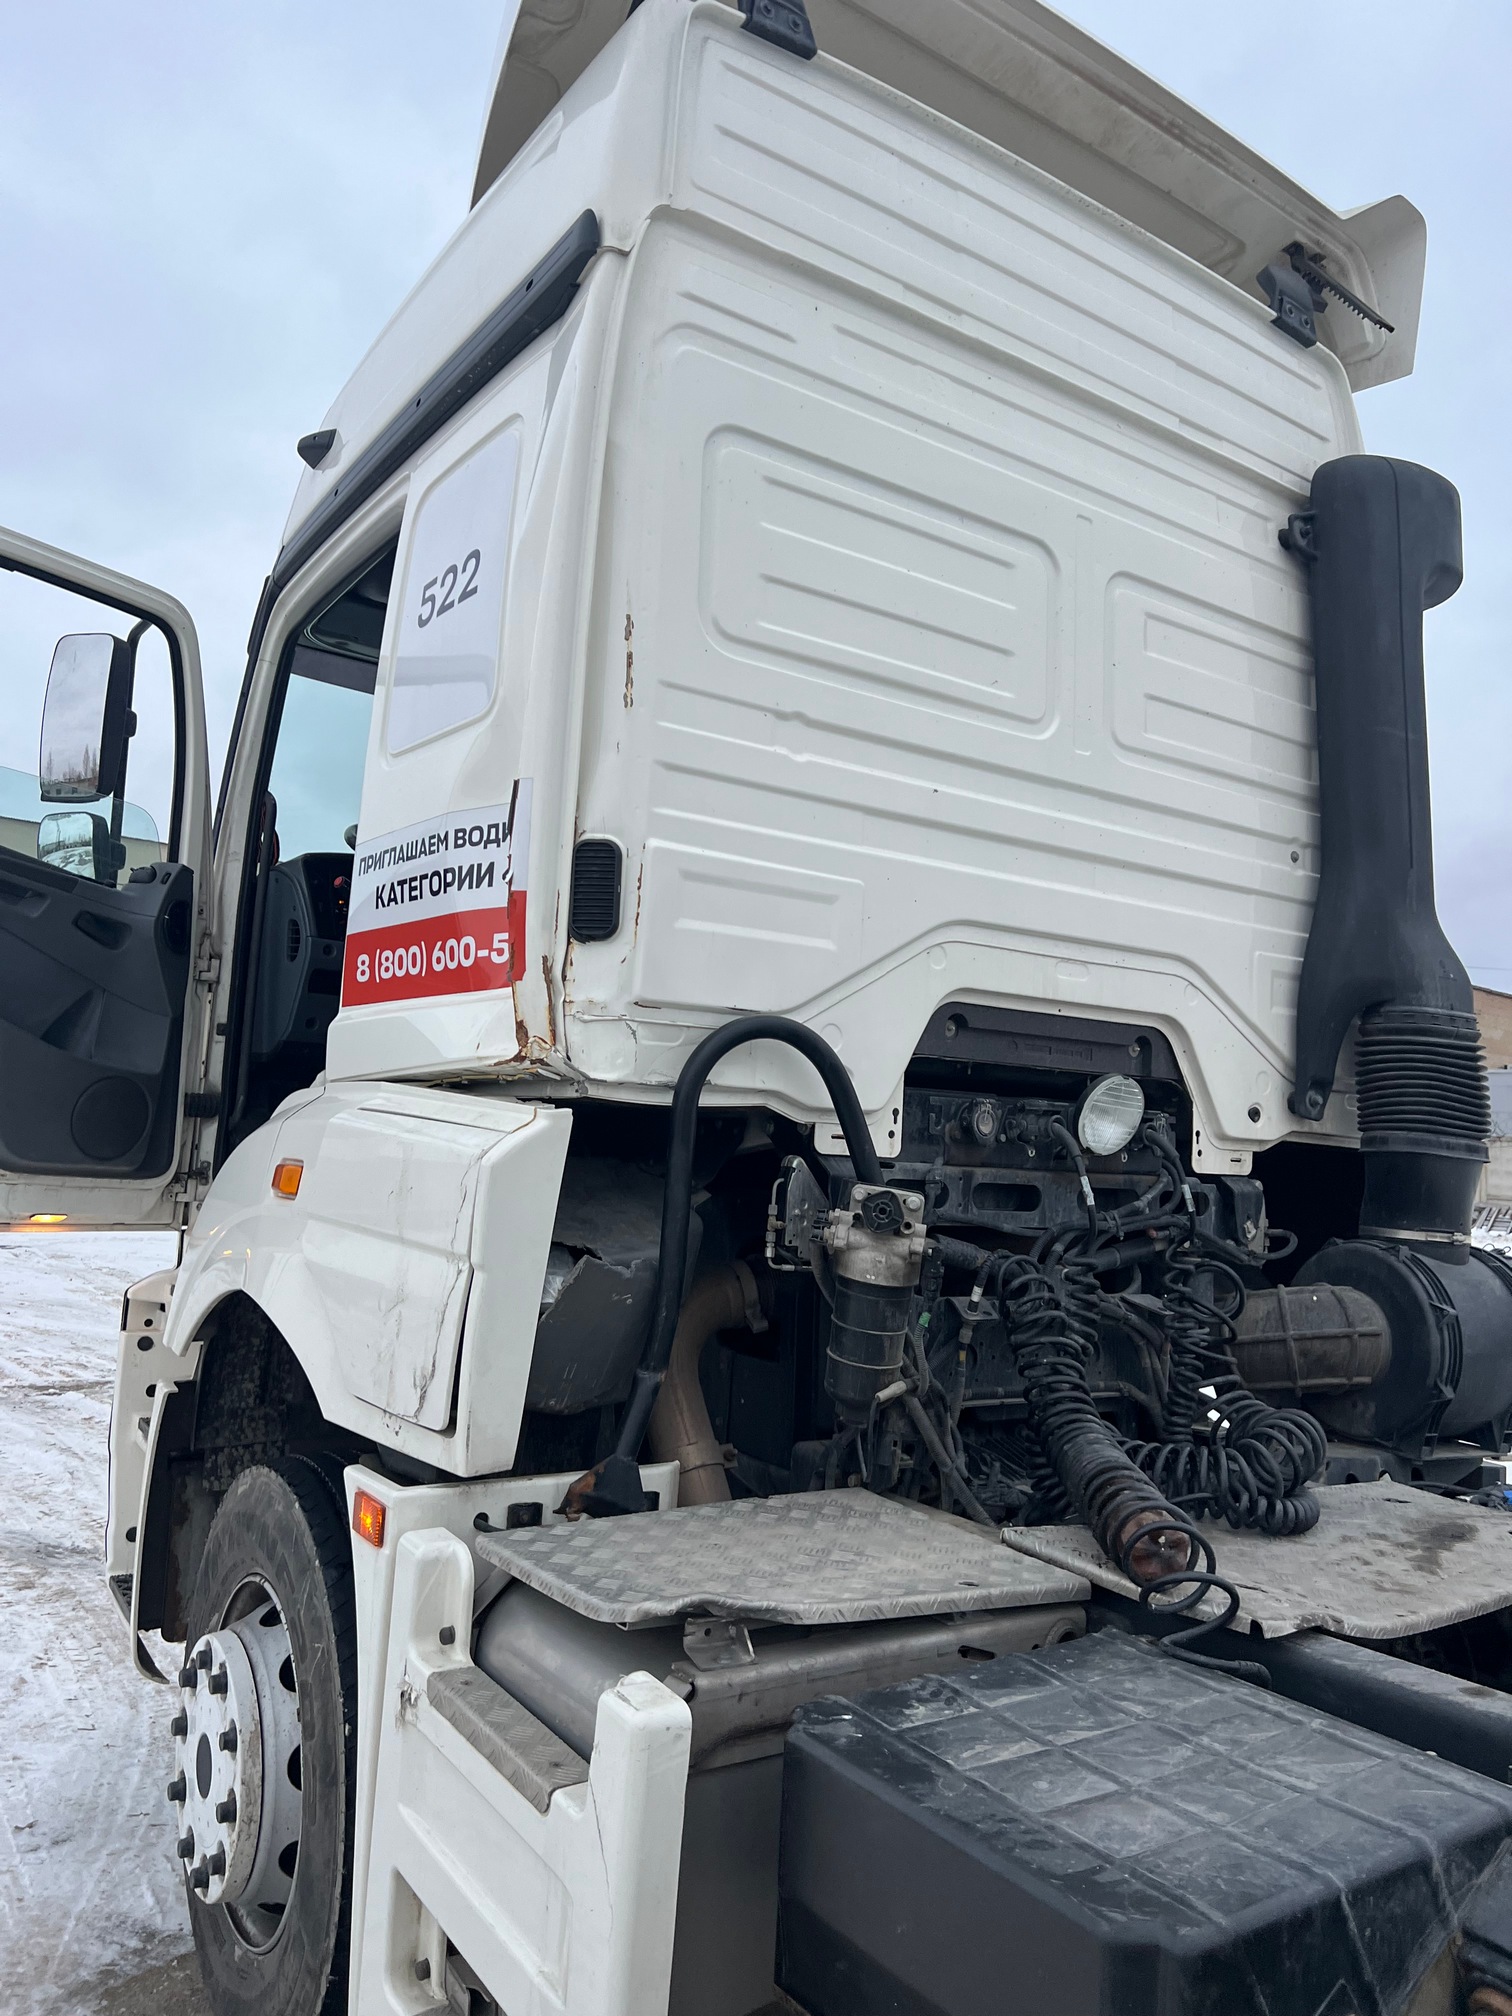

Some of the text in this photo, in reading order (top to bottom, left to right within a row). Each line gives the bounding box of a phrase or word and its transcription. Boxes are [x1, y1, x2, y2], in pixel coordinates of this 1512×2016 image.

[417, 548, 481, 629] 522
[358, 830, 449, 876] ПРИГЛАШАЕМ
[375, 861, 495, 909] КАТЕГОРИИ
[356, 954, 370, 983] 8
[375, 941, 426, 983] (800)
